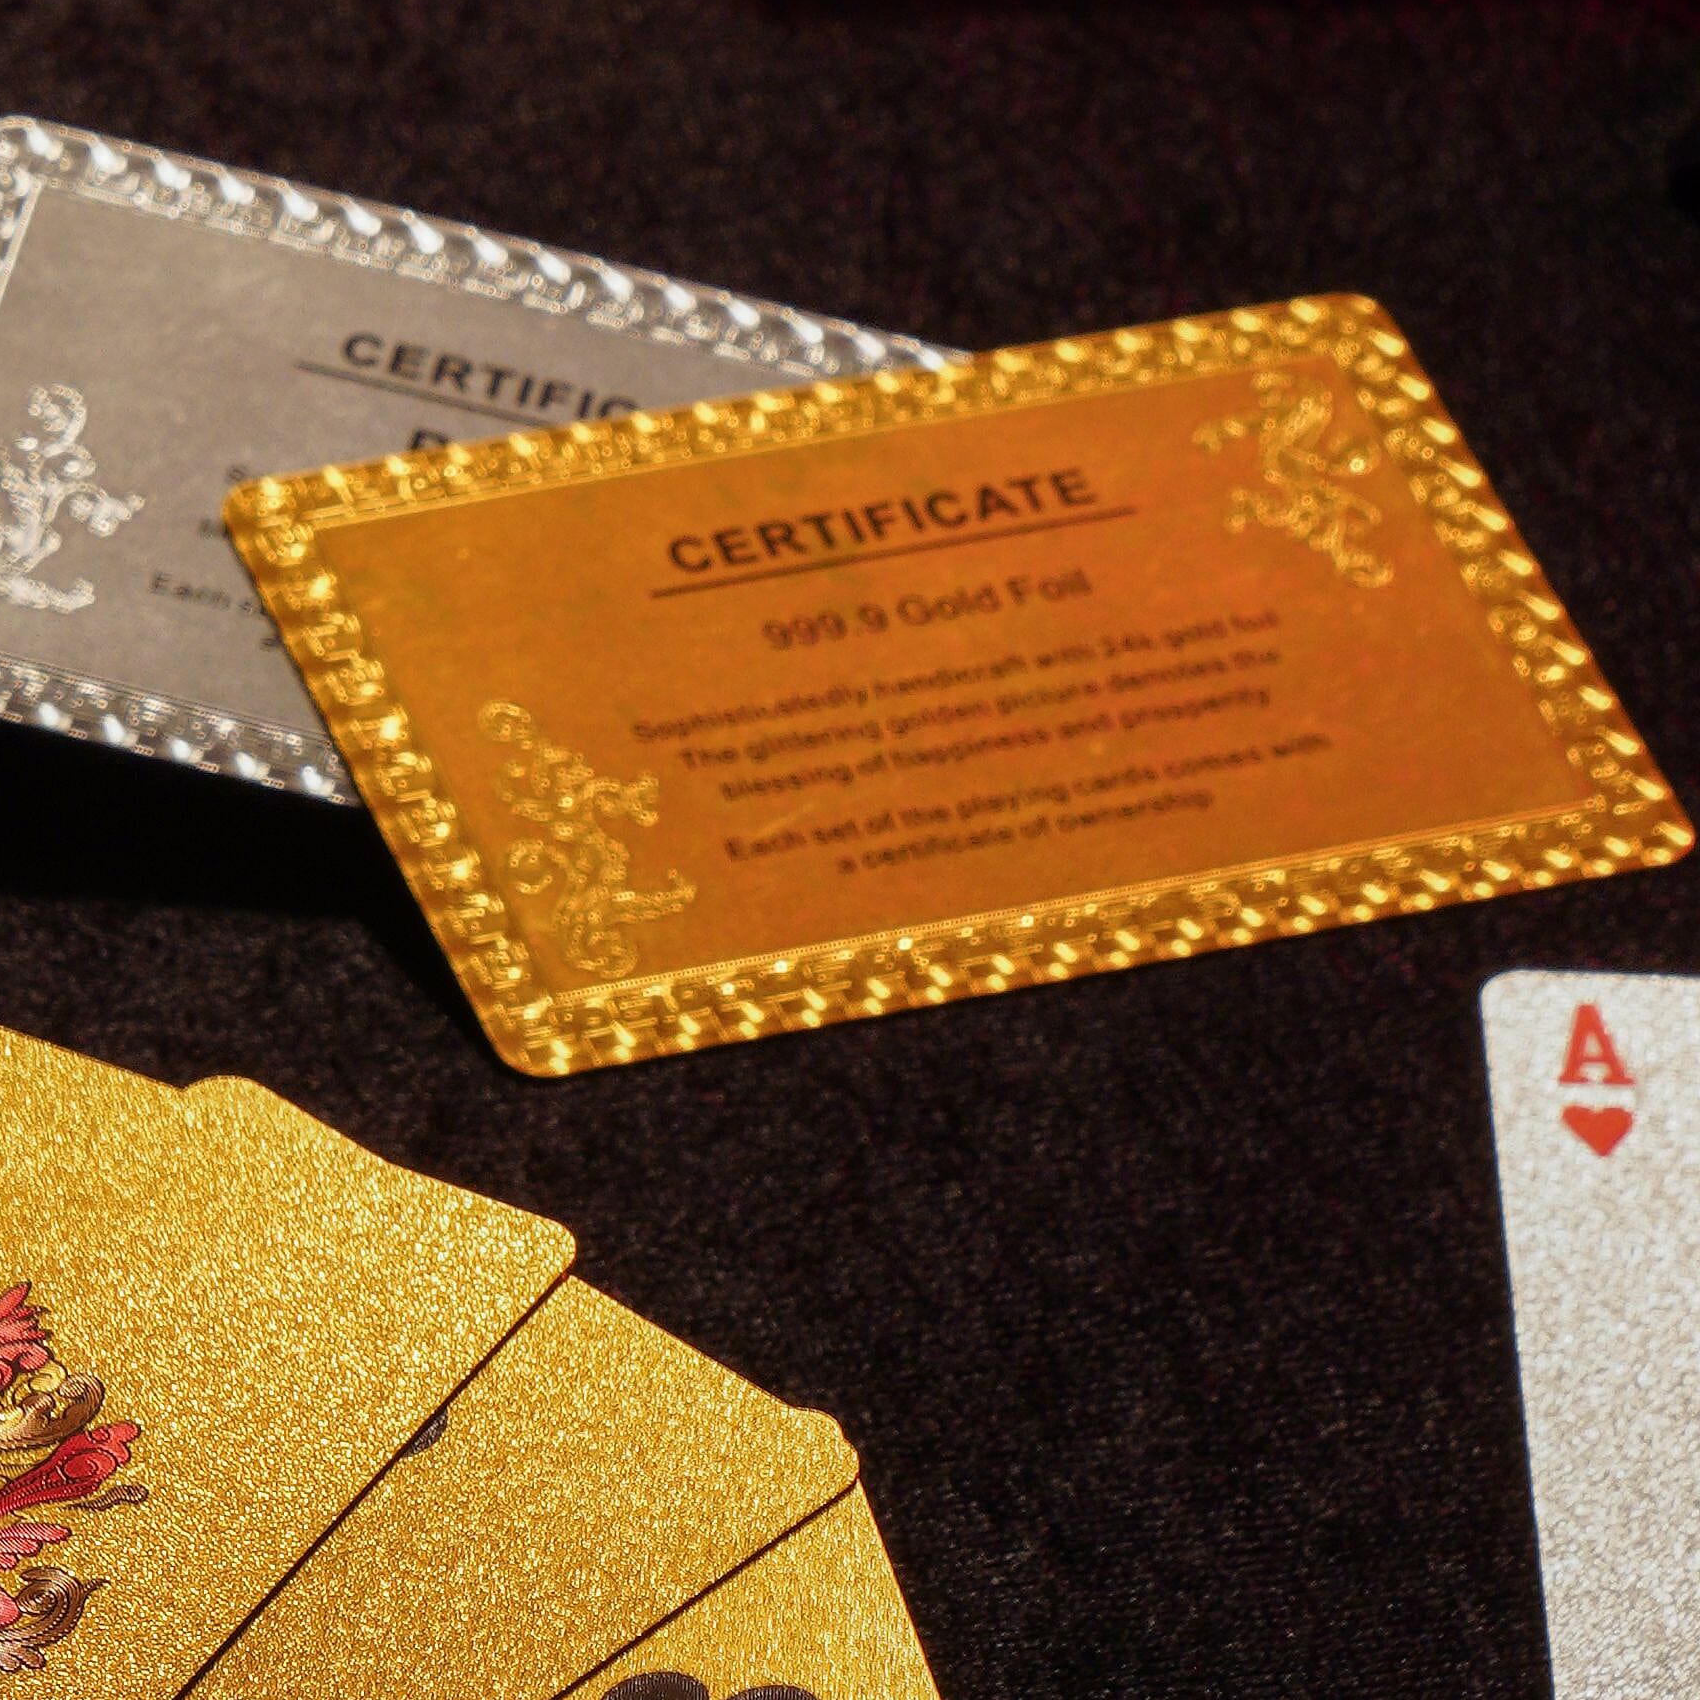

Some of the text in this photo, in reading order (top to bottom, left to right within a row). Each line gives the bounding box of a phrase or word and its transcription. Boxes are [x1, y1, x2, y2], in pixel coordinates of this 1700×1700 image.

[668, 467, 1095, 574] CERTIFICATE
[897, 580, 998, 626] Gold
[1007, 568, 1091, 606] Foil
[1163, 617, 1228, 650] gold
[680, 745, 738, 771] The
[886, 700, 991, 737] golden
[1230, 647, 1280, 671] the
[856, 751, 886, 775] of
[889, 729, 1050, 773] happiness
[1057, 712, 1114, 740] and
[724, 830, 806, 861] Each
[812, 818, 860, 846] set
[864, 810, 896, 836] of
[898, 804, 951, 829] the
[955, 784, 1069, 821] playing
[1072, 765, 1158, 796] cards
[1163, 746, 1263, 779] comes
[860, 827, 1015, 870] certificate
[1019, 813, 1050, 840] of
[1557, 1001, 1634, 1090] A
